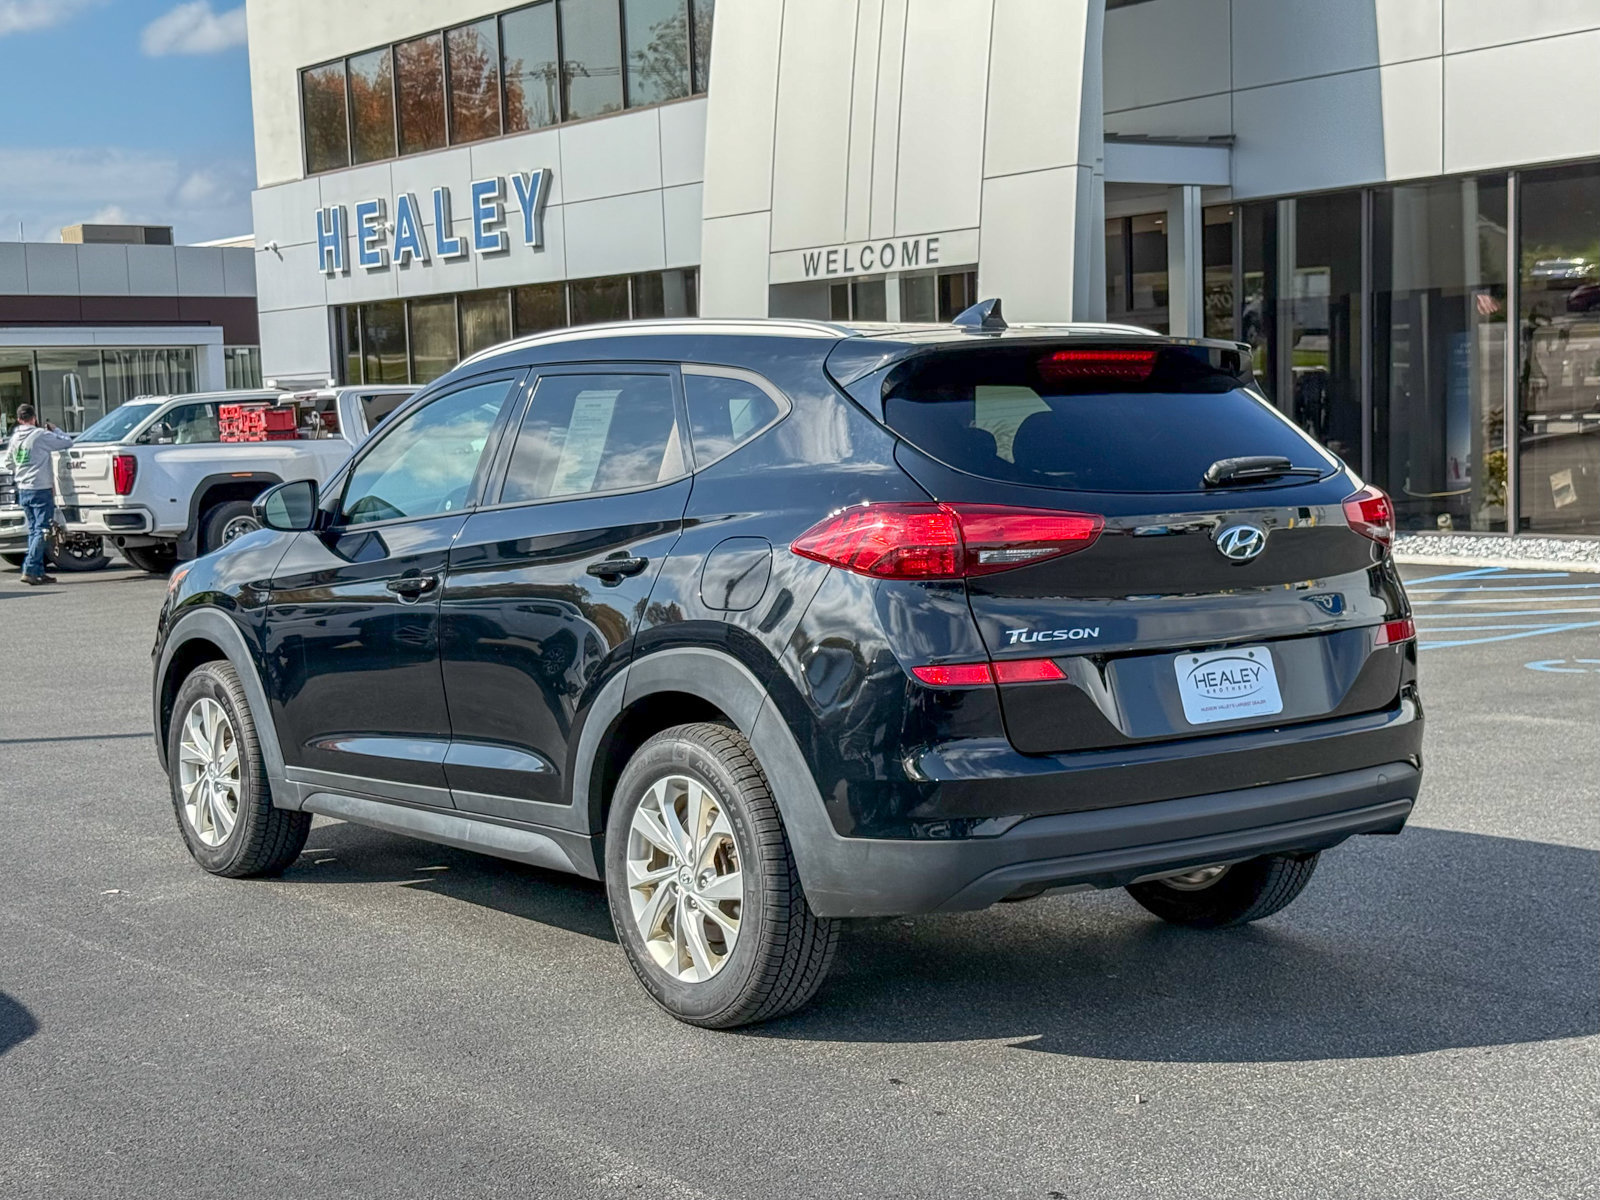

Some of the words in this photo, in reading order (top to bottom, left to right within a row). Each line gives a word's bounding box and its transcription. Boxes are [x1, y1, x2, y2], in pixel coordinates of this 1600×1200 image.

[315, 168, 551, 275] HEALEY
[803, 237, 940, 278] WELCOME
[1194, 666, 1261, 689] HEALEY
[1206, 683, 1253, 694] BROTHERS
[695, 760, 737, 812] ALTIMAX
